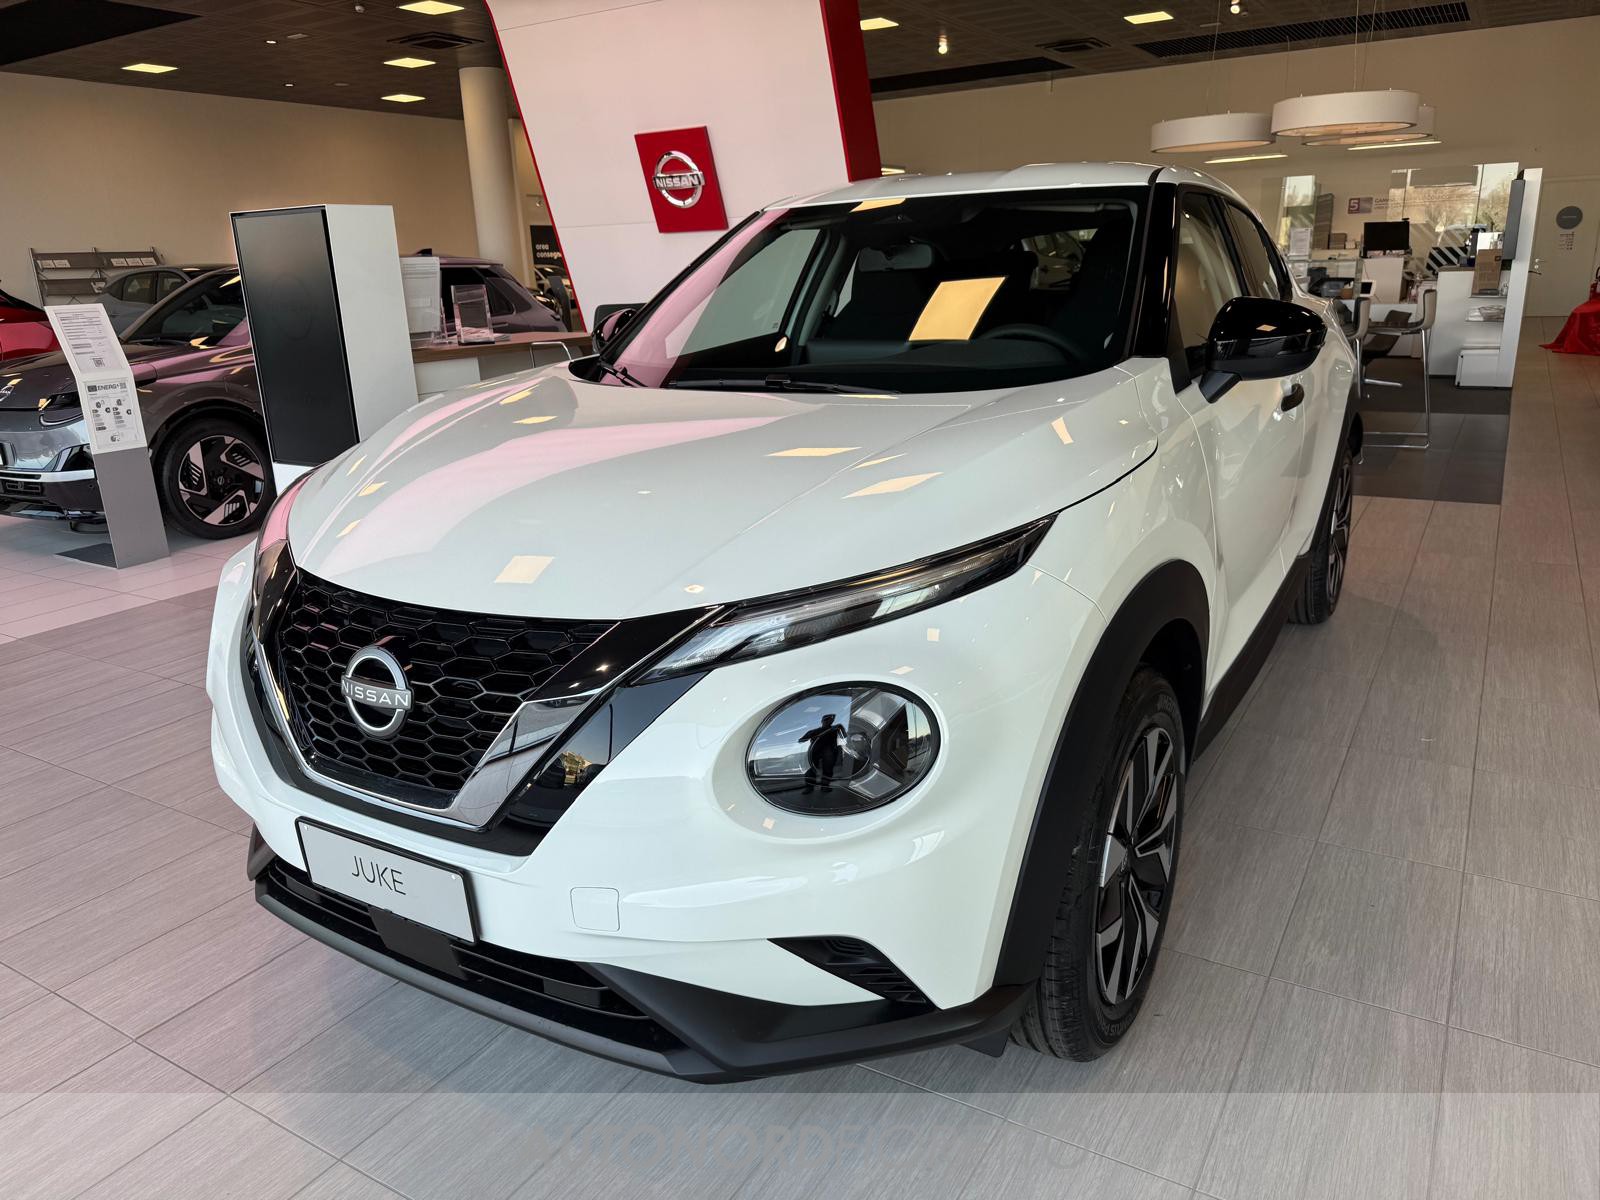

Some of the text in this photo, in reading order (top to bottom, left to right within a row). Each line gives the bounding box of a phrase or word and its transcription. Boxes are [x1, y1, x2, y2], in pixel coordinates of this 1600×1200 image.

[655, 174, 700, 188] NISSAN
[341, 679, 409, 706] NISSAN
[351, 855, 406, 896] JUKE
